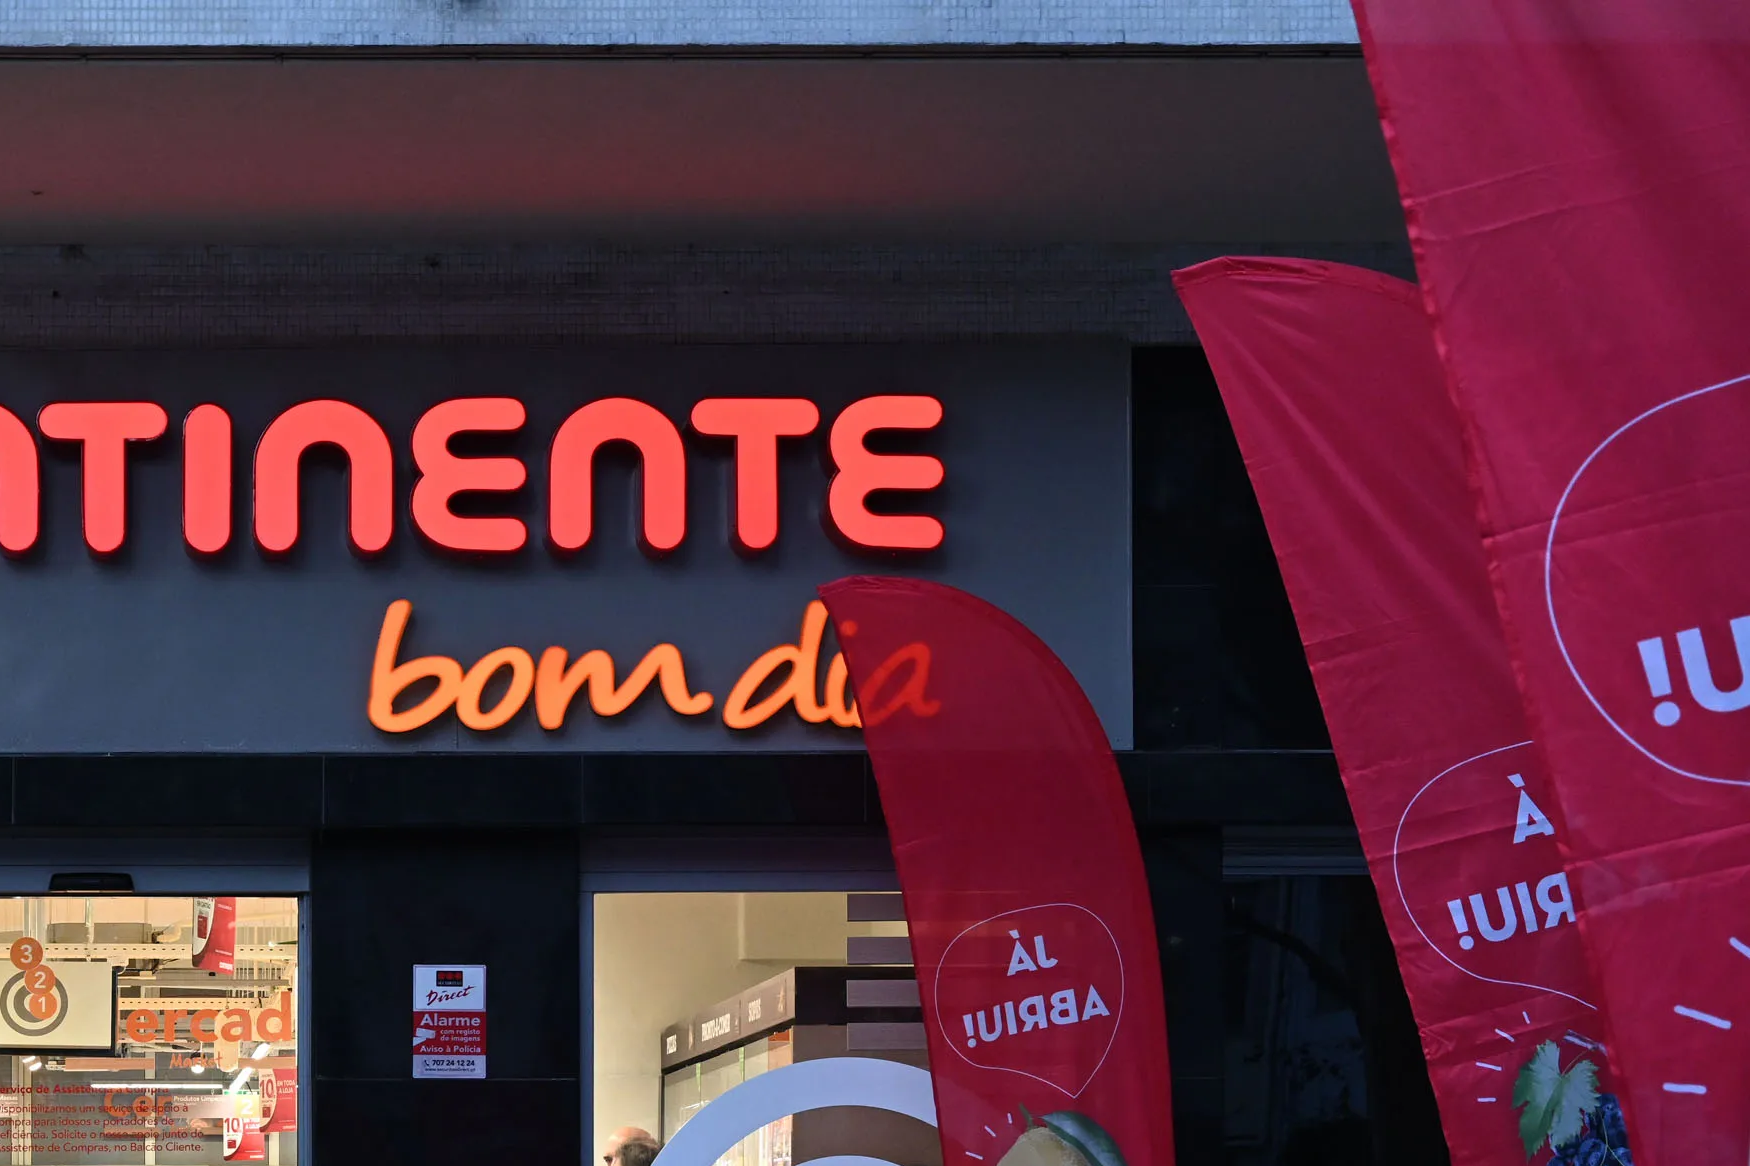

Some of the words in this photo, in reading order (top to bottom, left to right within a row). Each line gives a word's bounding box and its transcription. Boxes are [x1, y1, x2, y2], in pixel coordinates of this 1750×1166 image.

[369, 599, 713, 732] bom
[722, 599, 941, 729] dia
[20, 944, 33, 963] 3
[34, 971, 46, 989] 2
[426, 985, 477, 1006] Direct
[38, 996, 46, 1013] 1
[126, 991, 292, 1043] ercad
[420, 1013, 481, 1027] Alarme
[451, 1035, 481, 1043] imagens
[456, 1028, 481, 1036] registo
[420, 1045, 444, 1053] Aviso
[453, 1045, 481, 1053] Polícia
[38, 1084, 49, 1093] de
[98, 1103, 134, 1115] serviço
[136, 1103, 150, 1113] de
[151, 1103, 180, 1116] apoio
[241, 1099, 253, 1115] 2
[34, 1118, 56, 1130] para
[59, 1117, 91, 1127] idosos
[94, 1119, 100, 1127] e
[103, 1116, 158, 1129] portadores
[161, 1116, 175, 1126] de
[52, 1129, 88, 1140] Solicite
[89, 1131, 96, 1139] o
[161, 1129, 188, 1141] junto
[190, 1128, 205, 1139] do
[47, 1142, 61, 1153] de
[63, 1142, 111, 1155] Compras,
[114, 1144, 127, 1152] no
[130, 1142, 163, 1152] Balcão
[165, 1142, 205, 1152] Cliente.
